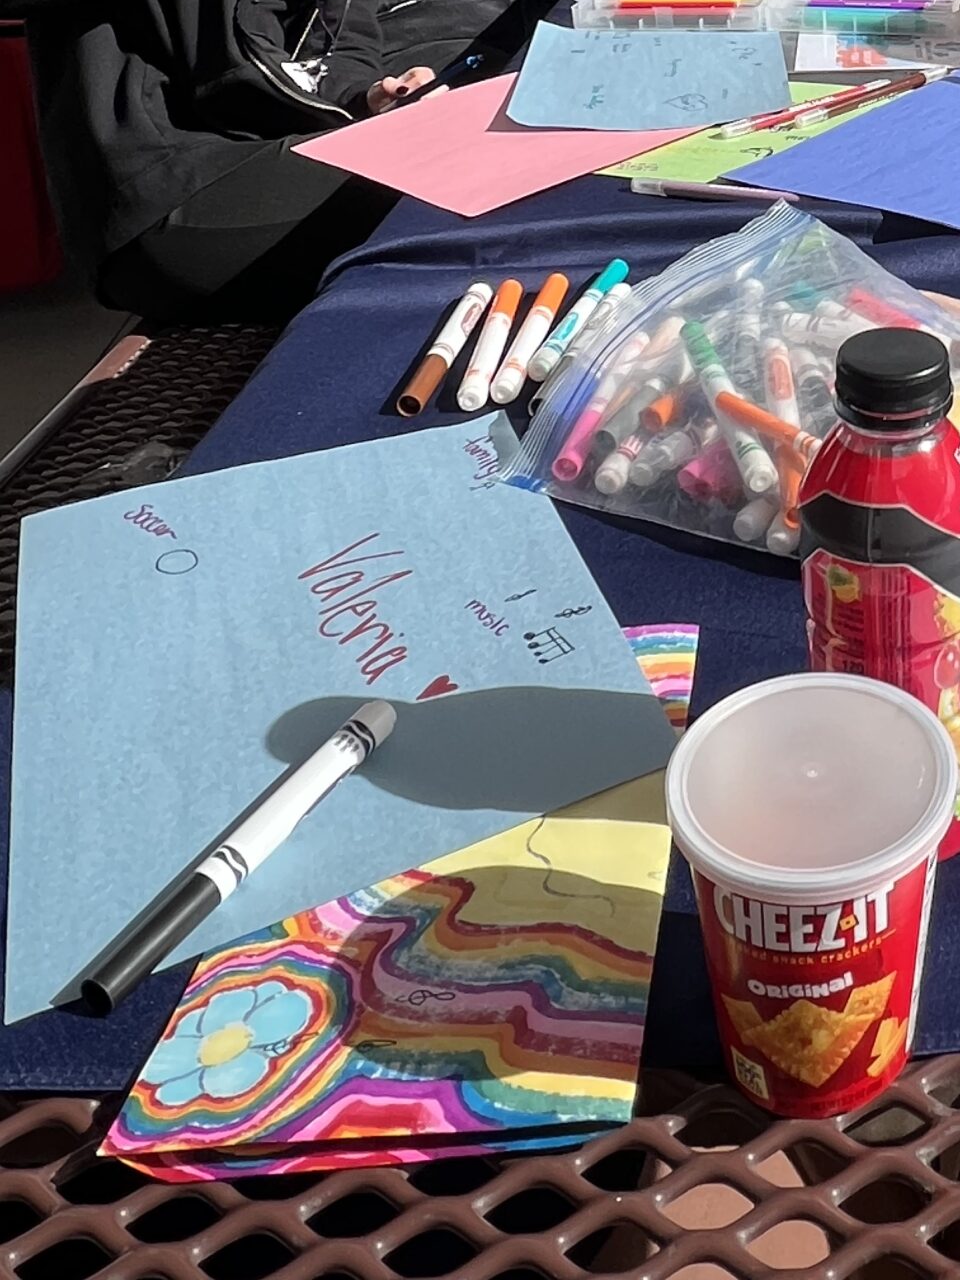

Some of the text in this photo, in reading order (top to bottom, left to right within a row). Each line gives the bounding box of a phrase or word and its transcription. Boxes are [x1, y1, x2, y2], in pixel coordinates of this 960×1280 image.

[298, 532, 413, 685] Valeria
[464, 598, 510, 637] music
[820, 938, 882, 964] crackers
